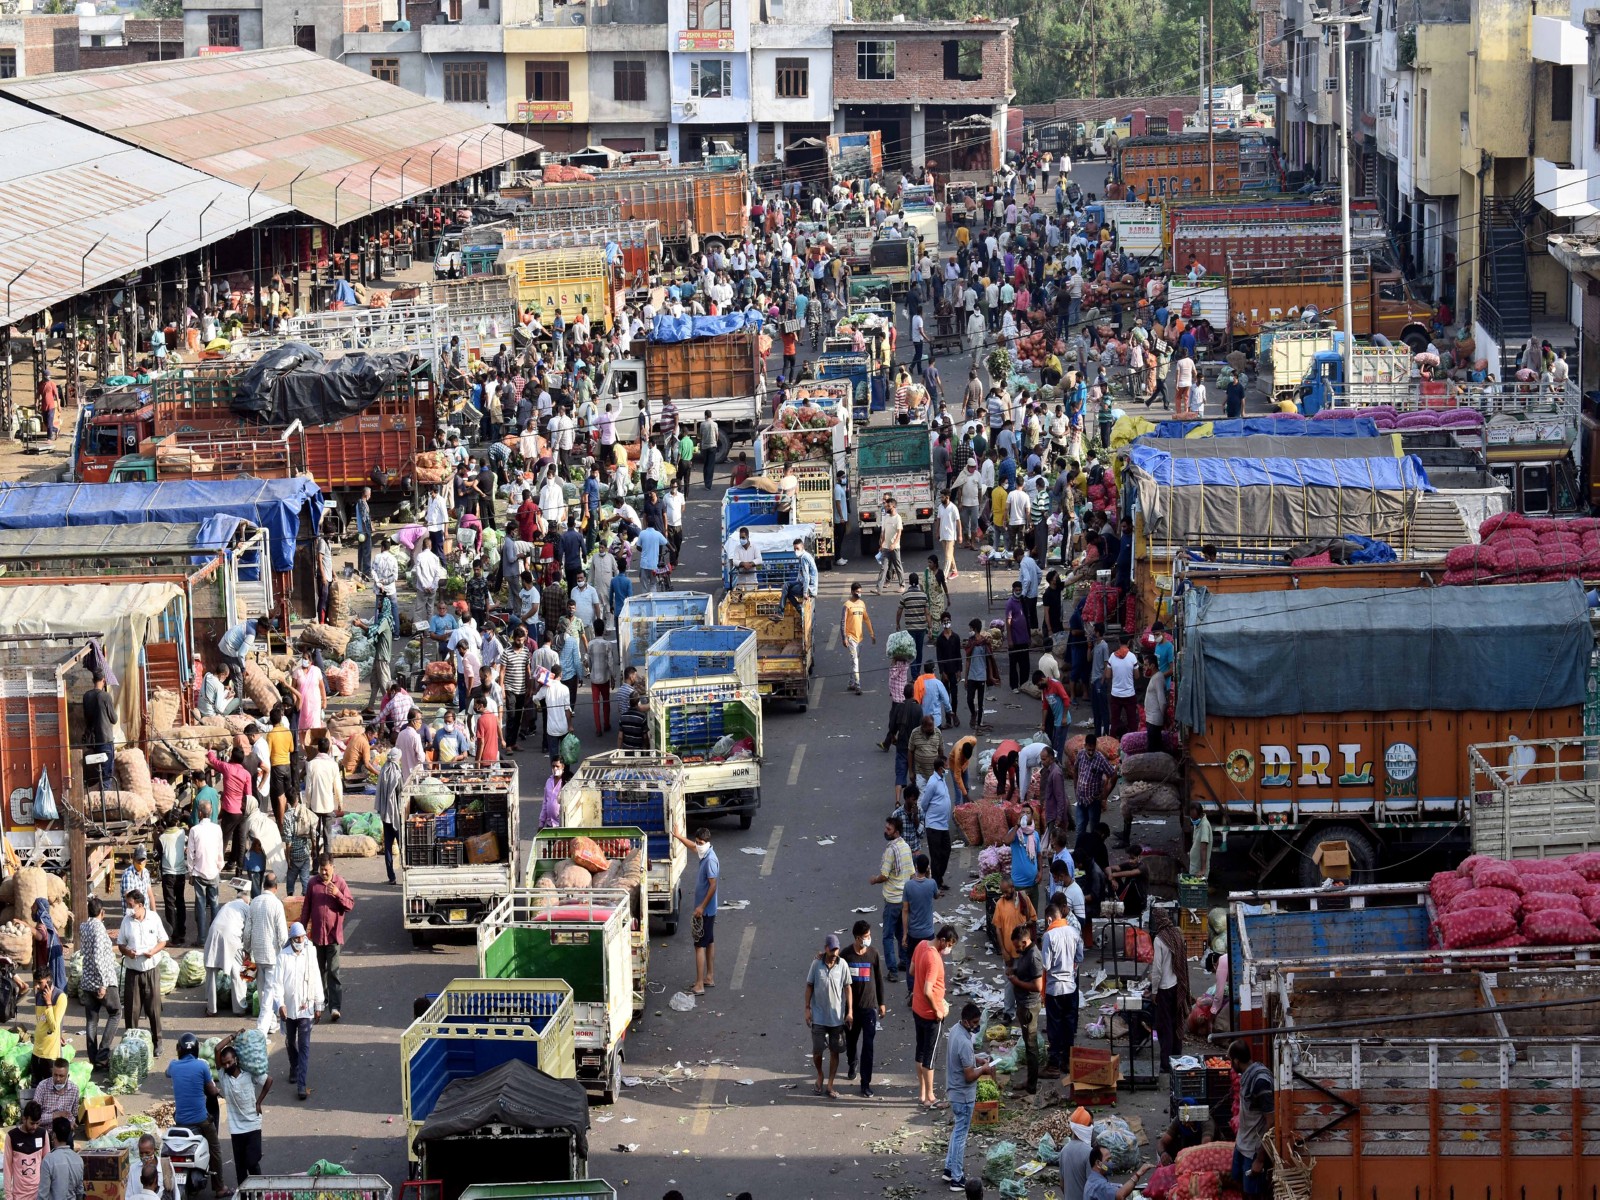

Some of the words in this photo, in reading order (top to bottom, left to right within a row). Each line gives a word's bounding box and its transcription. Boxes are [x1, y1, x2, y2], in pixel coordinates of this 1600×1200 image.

[1393, 745, 1408, 753] ALL
[1387, 754, 1414, 768] INDIA
[733, 767, 750, 776] HORN
